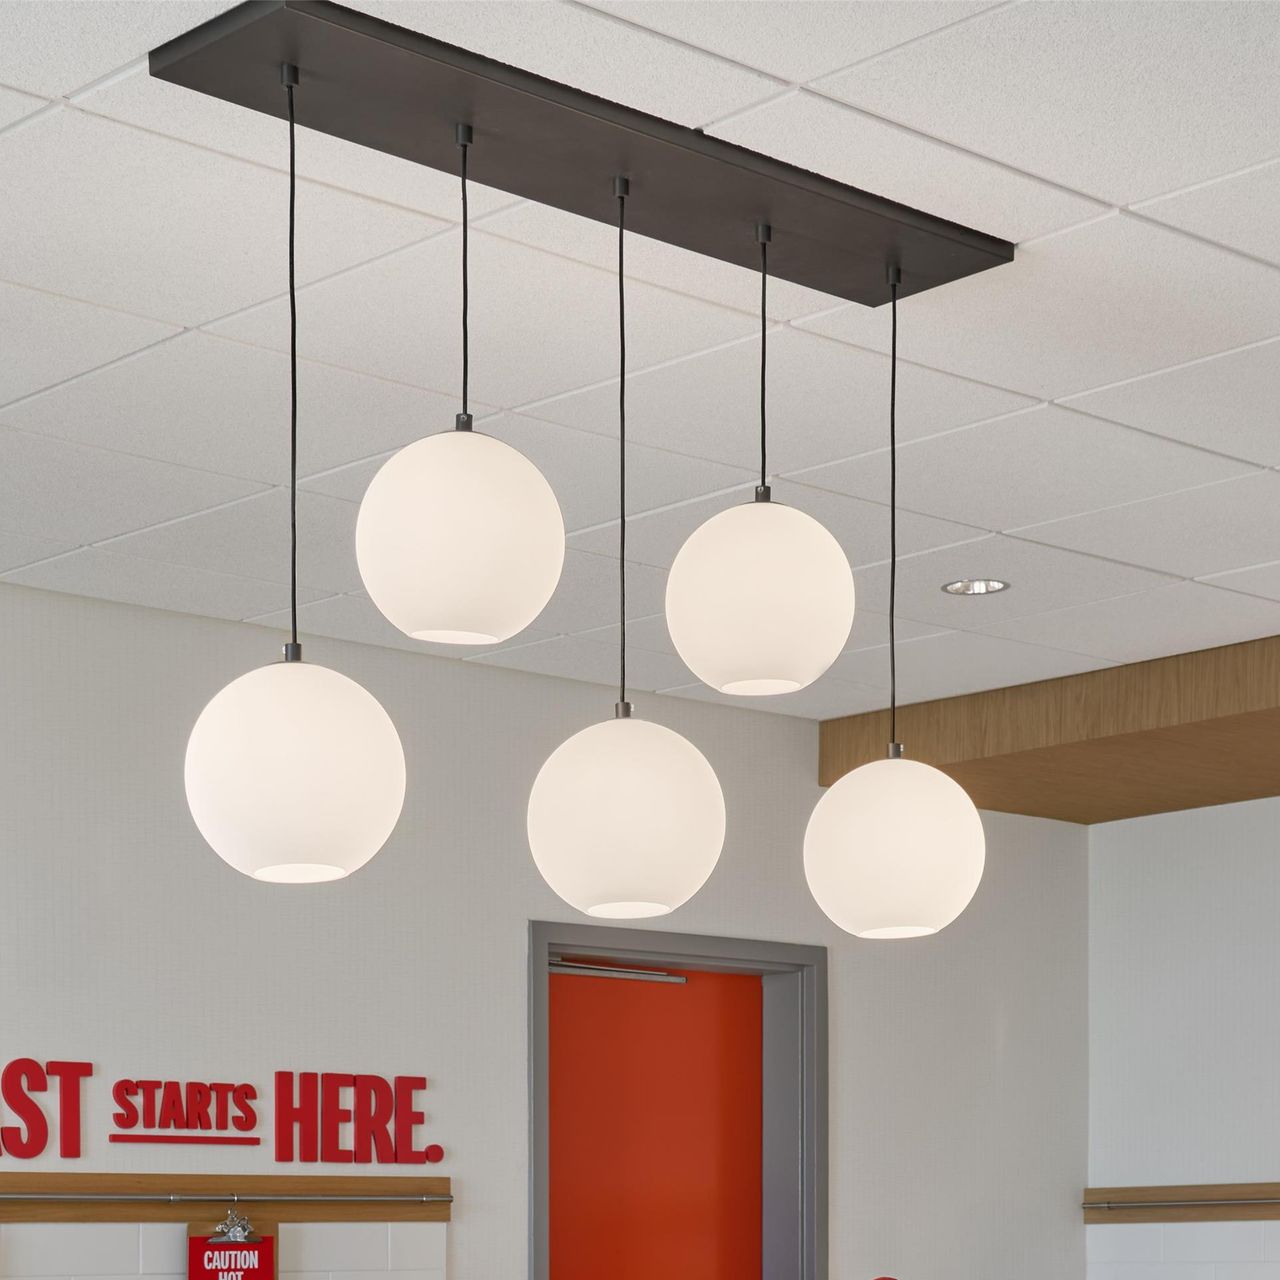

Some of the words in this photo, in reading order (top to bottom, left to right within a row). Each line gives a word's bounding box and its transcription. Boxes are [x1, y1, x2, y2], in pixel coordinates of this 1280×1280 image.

[112, 1078, 258, 1133] STARTS
[274, 1070, 445, 1165] HERE.
[203, 1250, 259, 1270] CAUTION
